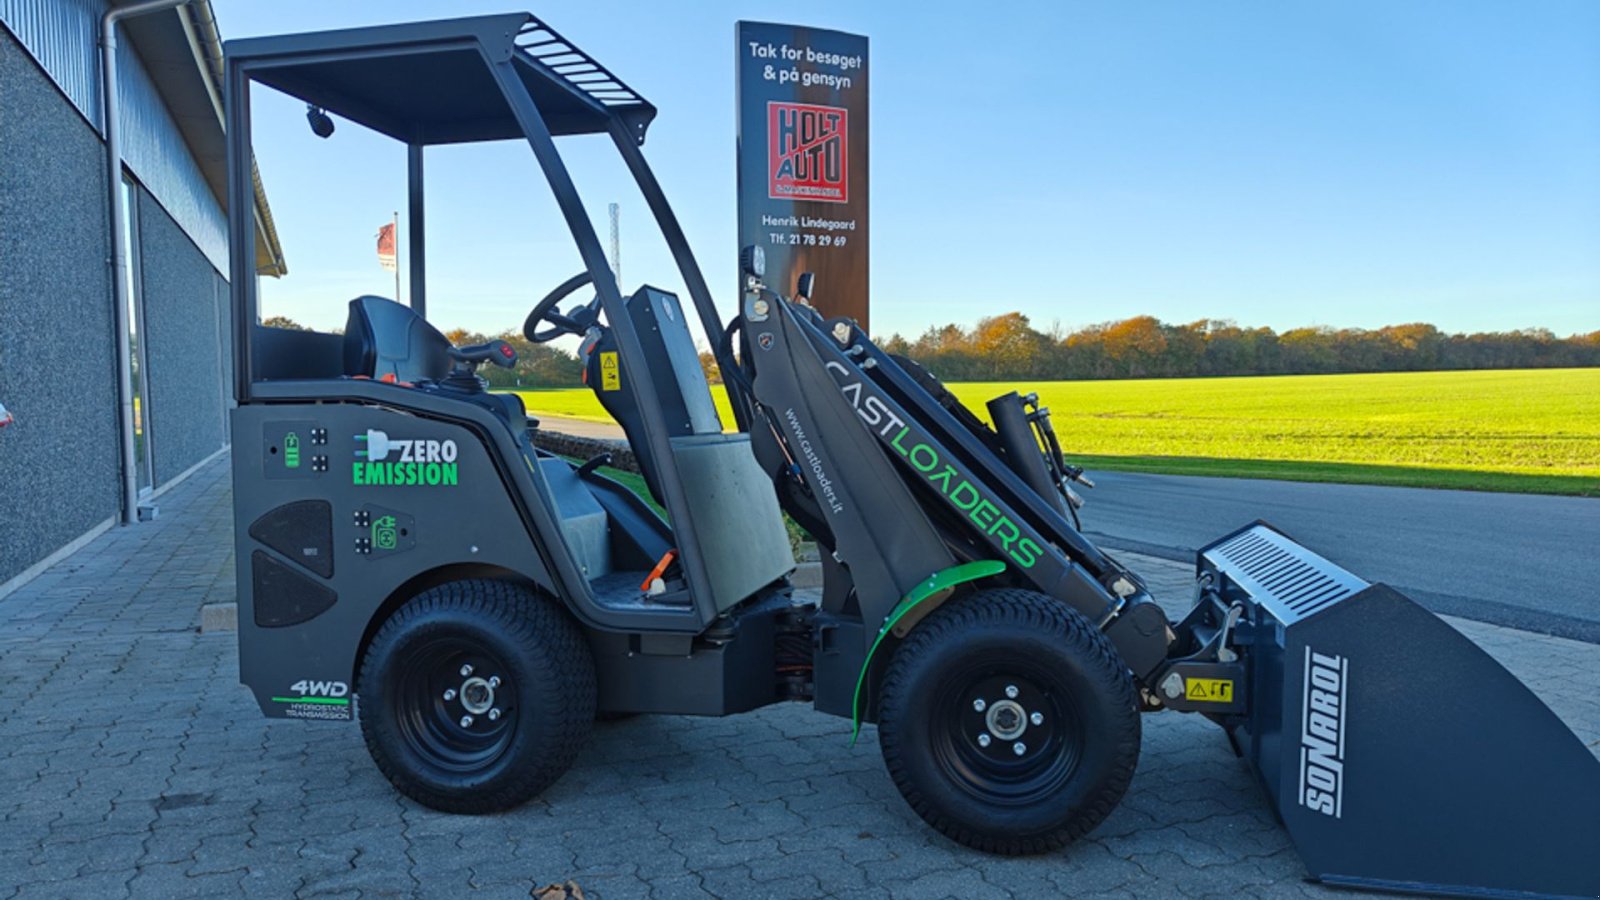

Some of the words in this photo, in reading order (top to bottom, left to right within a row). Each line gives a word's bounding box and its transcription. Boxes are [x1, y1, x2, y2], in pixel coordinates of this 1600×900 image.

[749, 42, 777, 59] Tak
[780, 44, 803, 60] for
[806, 47, 862, 70] besøget
[763, 65, 776, 80] &
[779, 66, 799, 84] på
[802, 73, 851, 90] gensyn
[778, 107, 841, 157] HOLT
[776, 134, 841, 184] AUTO
[762, 215, 799, 227] Henrik
[801, 216, 856, 230] Lindegaard
[770, 233, 787, 245] Tlf.
[789, 234, 801, 245] 21
[803, 234, 816, 246] 78
[818, 235, 831, 246] 29
[833, 235, 846, 247] 69
[400, 440, 458, 463] ZERO
[785, 407, 843, 514] www.castloaders.it
[353, 462, 458, 485] EMISSION
[290, 680, 348, 697] 4WD
[285, 709, 350, 720] TRANSMISSION
[291, 703, 349, 713] HYDROSTATIC
[1302, 652, 1343, 816] SONAROL
